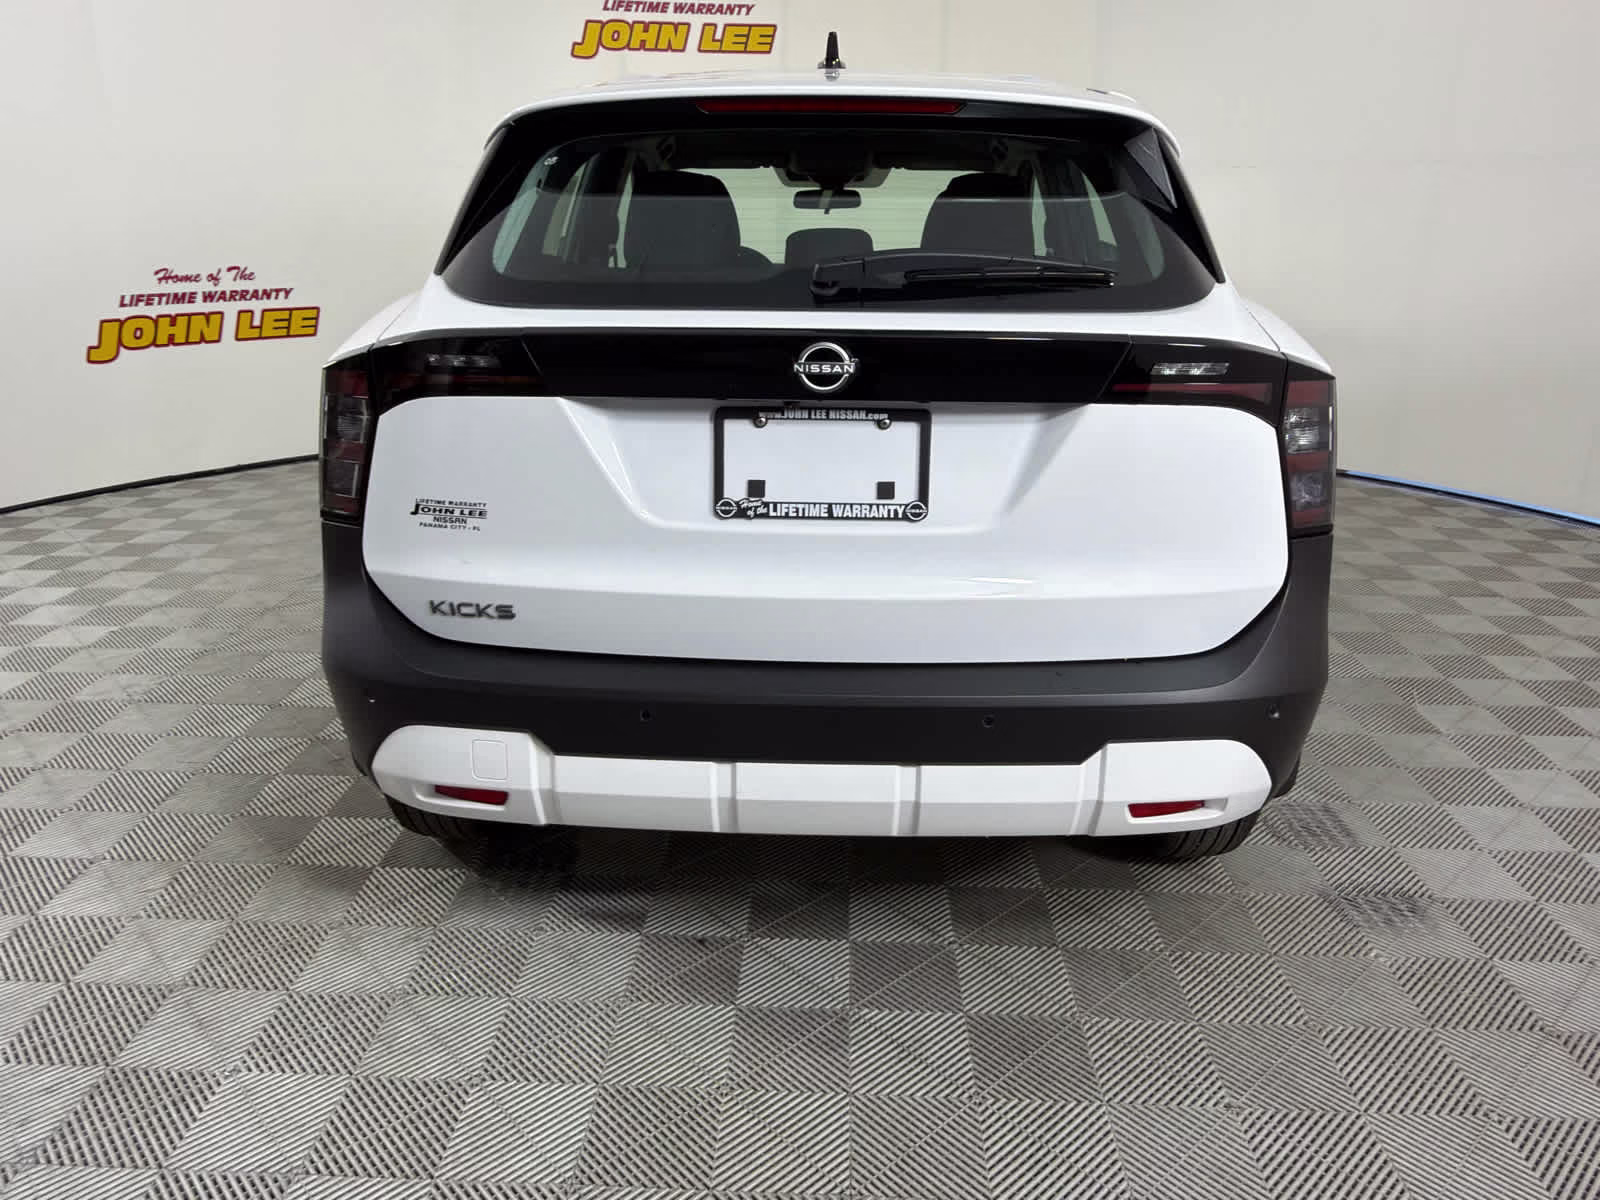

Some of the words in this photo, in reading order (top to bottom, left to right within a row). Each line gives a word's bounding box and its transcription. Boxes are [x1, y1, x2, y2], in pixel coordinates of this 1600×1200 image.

[602, 0, 670, 13] LIFETIME
[673, 2, 756, 16] WARRANTY
[571, 18, 691, 60] JOHN
[697, 22, 778, 55] LEE
[154, 267, 202, 285] Home
[206, 267, 222, 287] of
[226, 265, 256, 282] The
[119, 291, 197, 308] LIFETIME
[201, 287, 294, 304] WARRANTY
[86, 311, 225, 365] JOHN
[235, 306, 320, 341] LEE
[793, 363, 856, 374] NISSAN
[811, 409, 828, 420] LEE
[415, 498, 446, 506] LIFETIME
[739, 498, 762, 510] Home
[410, 503, 455, 515] JOHN
[459, 509, 489, 517] LEE
[746, 507, 756, 518] of
[756, 505, 768, 514] the
[769, 503, 829, 517] LIFETIME
[832, 504, 906, 519] WARRANTY
[432, 516, 468, 525] NISSAN
[429, 599, 517, 620] KICKS
